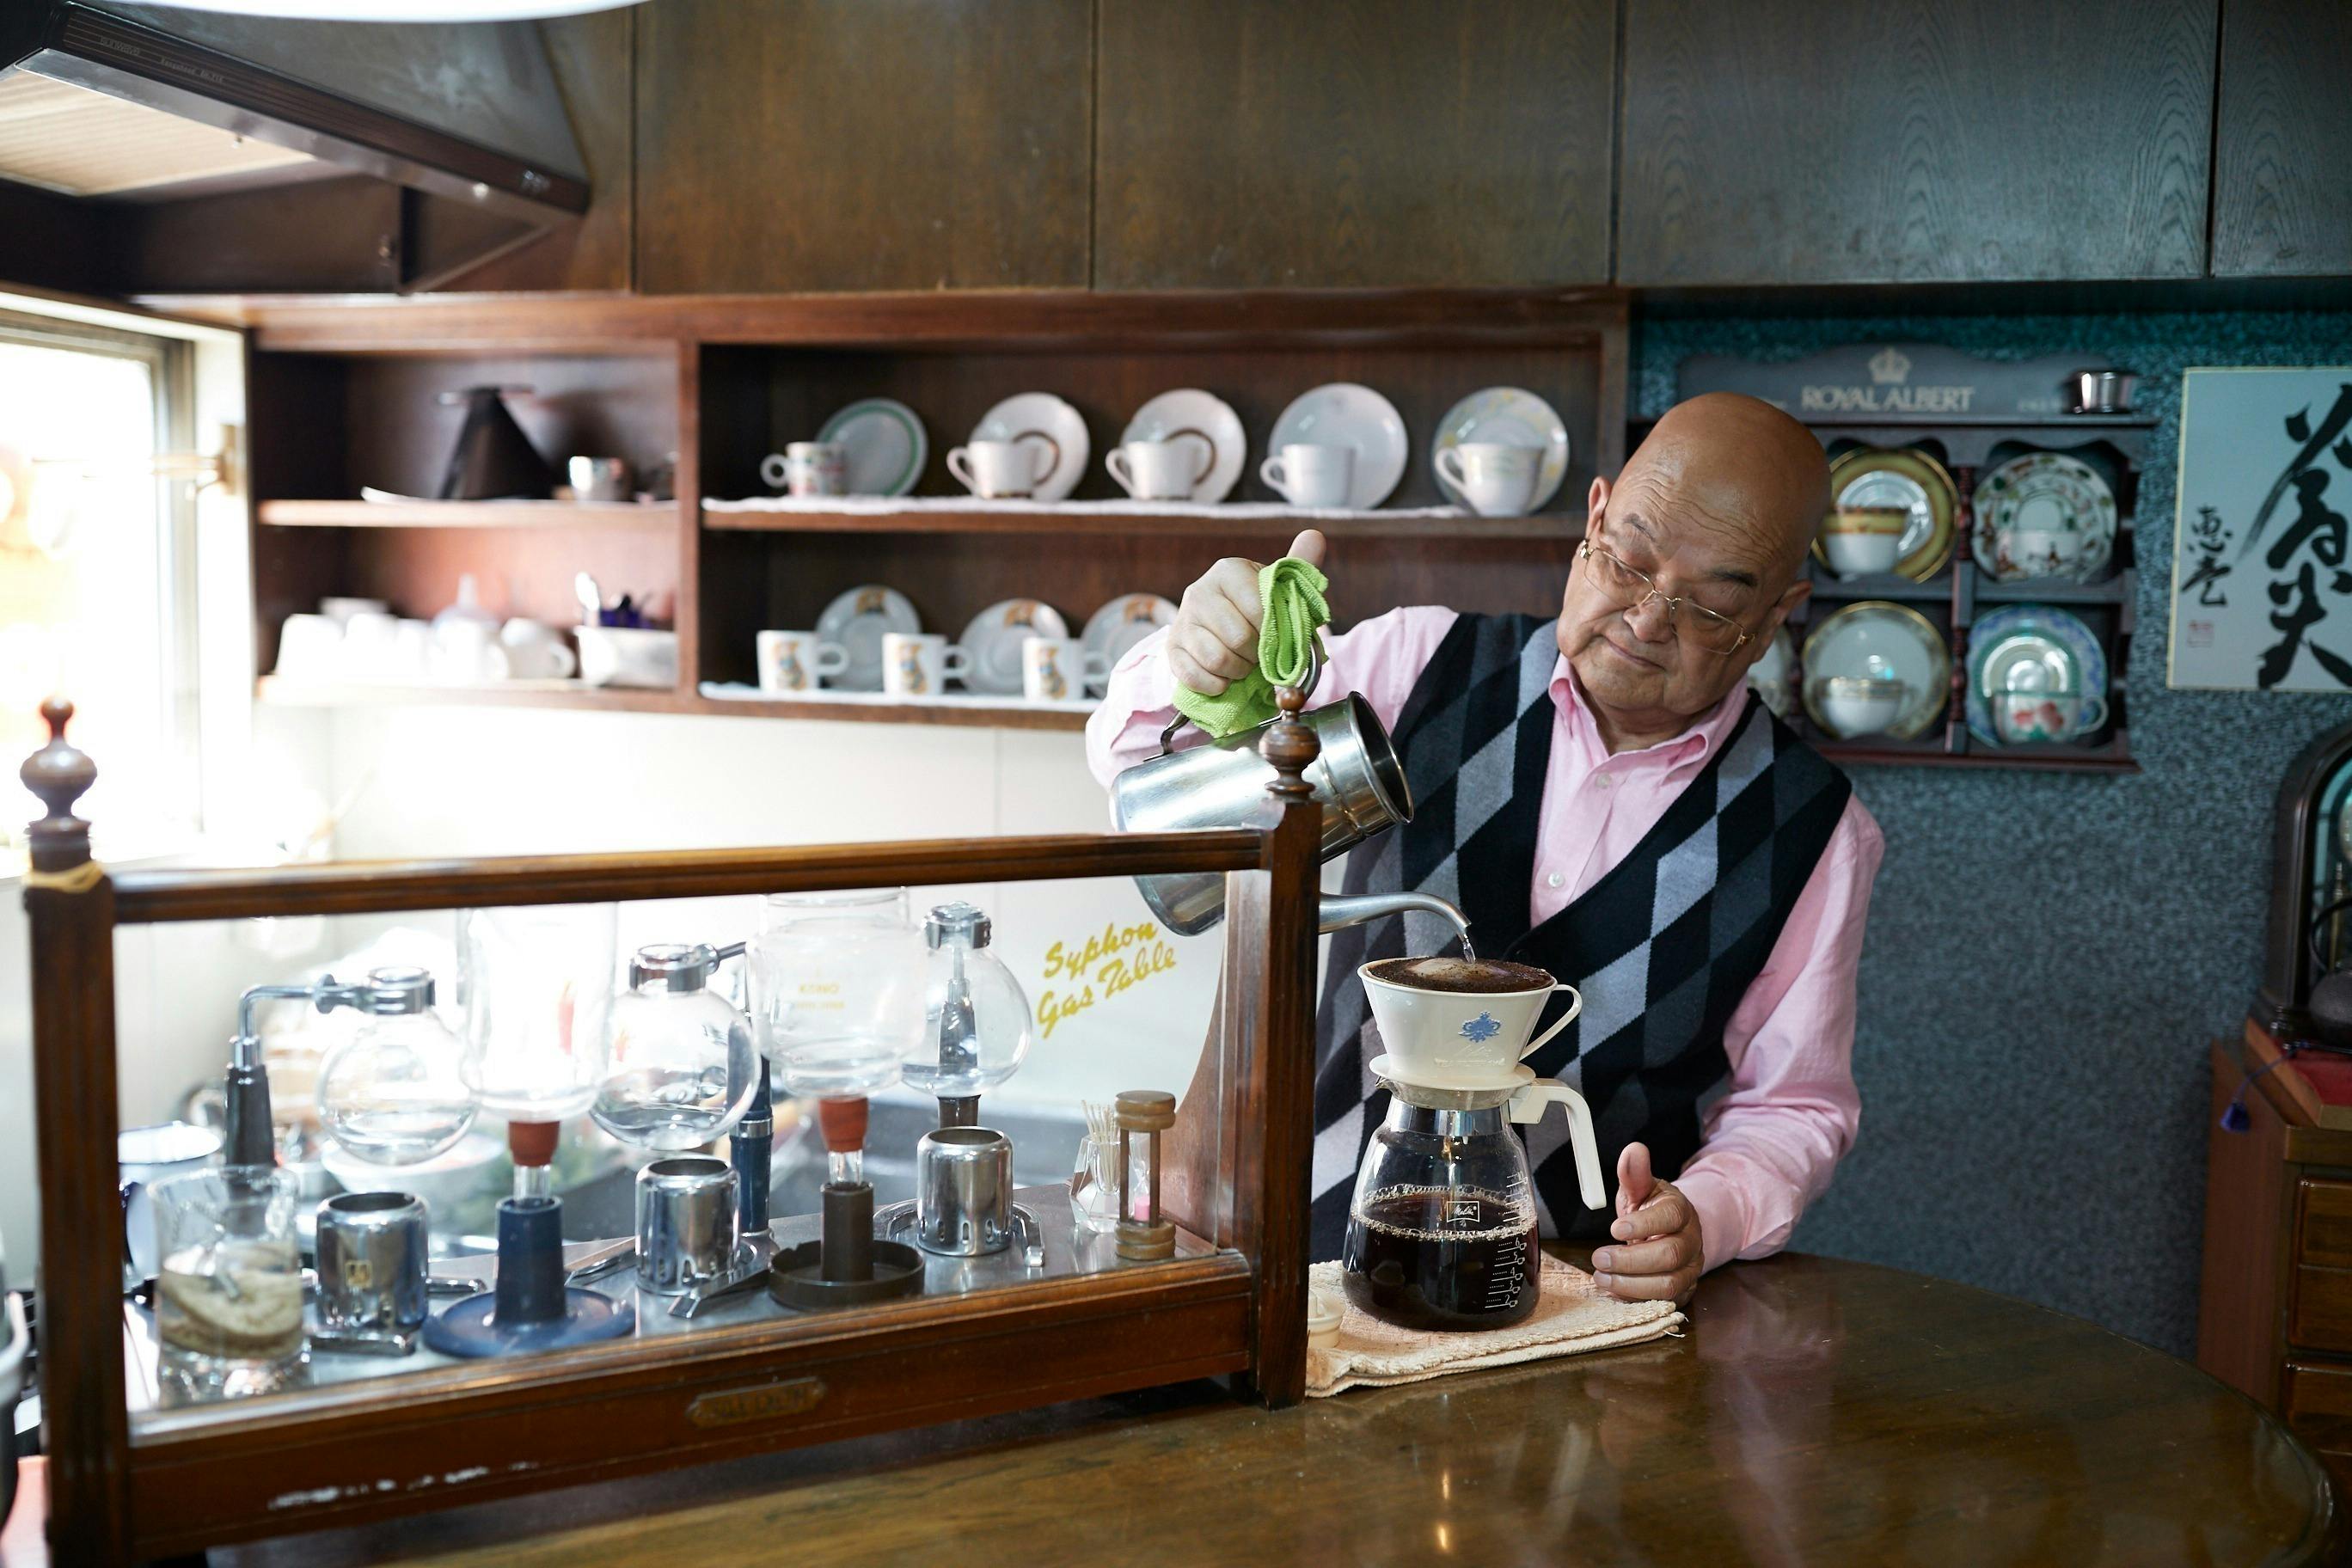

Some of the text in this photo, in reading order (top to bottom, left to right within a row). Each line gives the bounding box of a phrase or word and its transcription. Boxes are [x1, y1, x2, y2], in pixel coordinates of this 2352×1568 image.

[1802, 386, 1880, 412] ROYAL
[1883, 386, 1975, 412] ALBERT
[1044, 922, 1158, 980] Syphon
[1038, 940, 1176, 1039] Gas Table
[1510, 1266, 1516, 1277] 4
